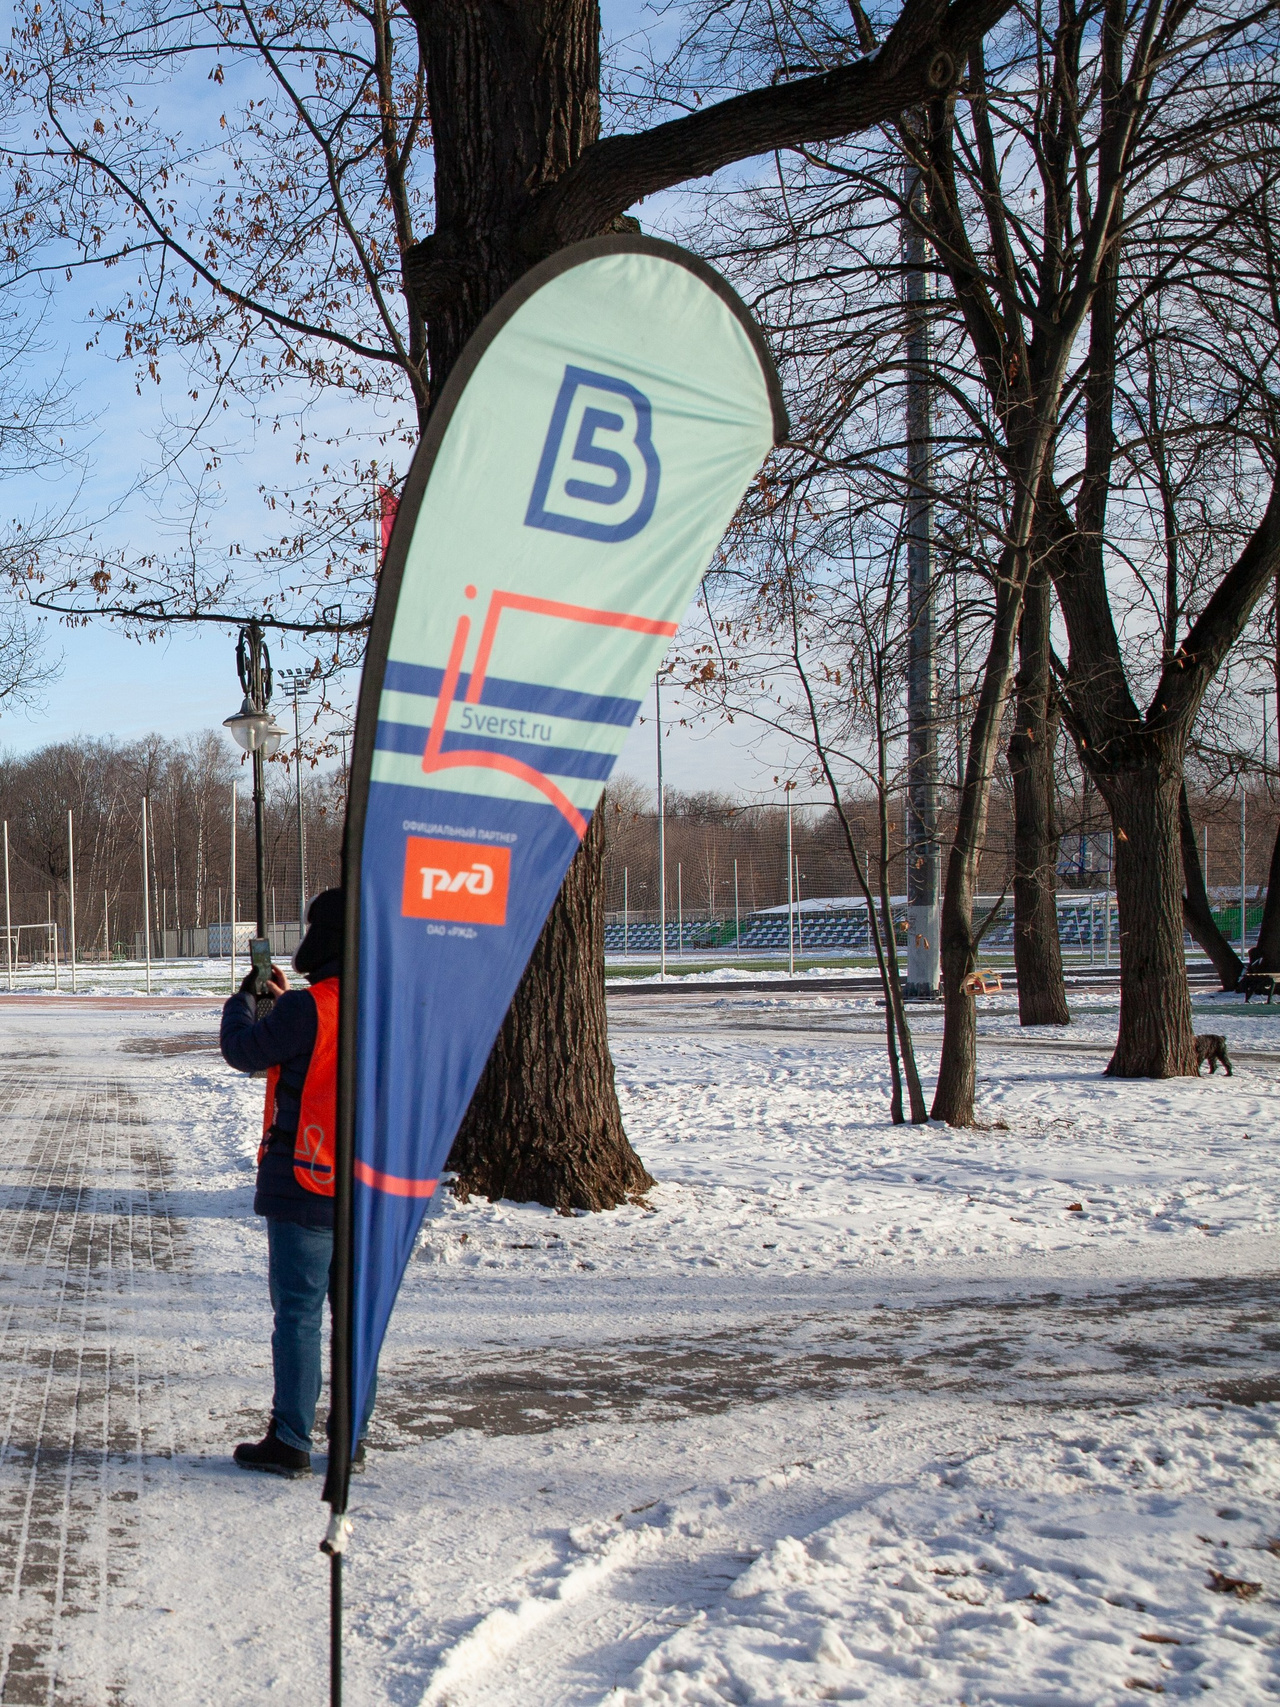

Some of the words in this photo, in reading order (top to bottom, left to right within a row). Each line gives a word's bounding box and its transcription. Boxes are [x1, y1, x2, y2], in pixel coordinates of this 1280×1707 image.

[460, 706, 552, 741] 5verst.ru
[402, 820, 477, 838] ОФИЦИАЛЬНЫЙ
[477, 829, 518, 843] ПАРТНЕР
